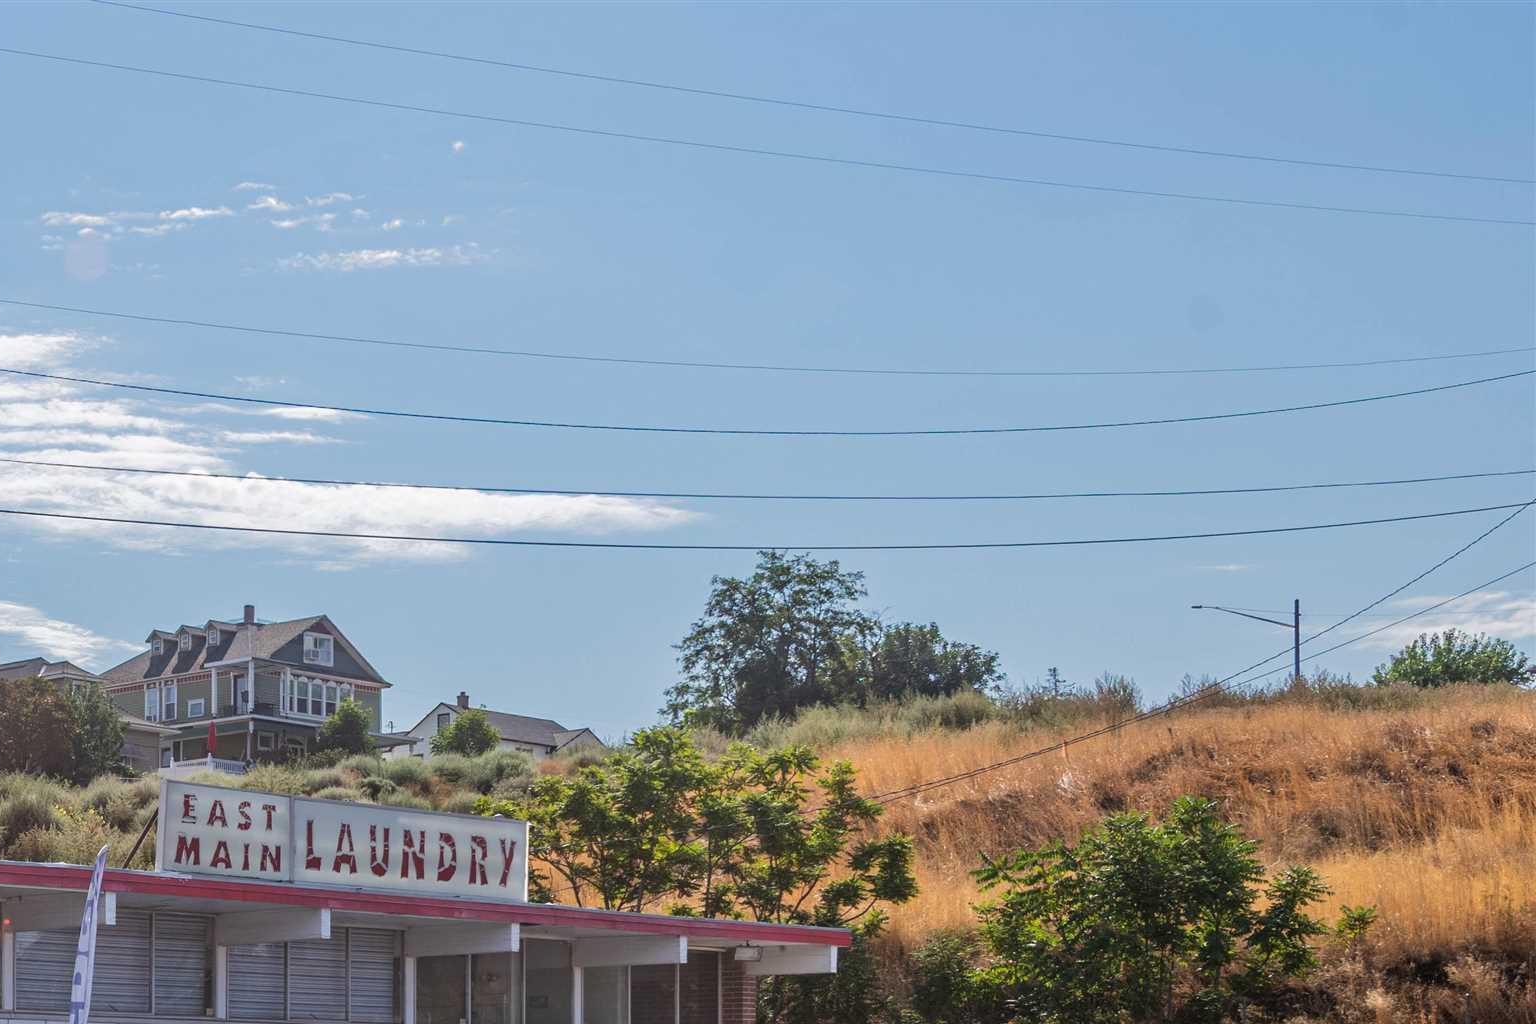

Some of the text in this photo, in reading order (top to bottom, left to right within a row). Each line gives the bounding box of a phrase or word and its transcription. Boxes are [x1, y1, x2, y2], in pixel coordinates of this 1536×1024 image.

[181, 793, 277, 832] EAST
[174, 834, 282, 873] MAIN
[305, 819, 517, 888] LAUNDRY
